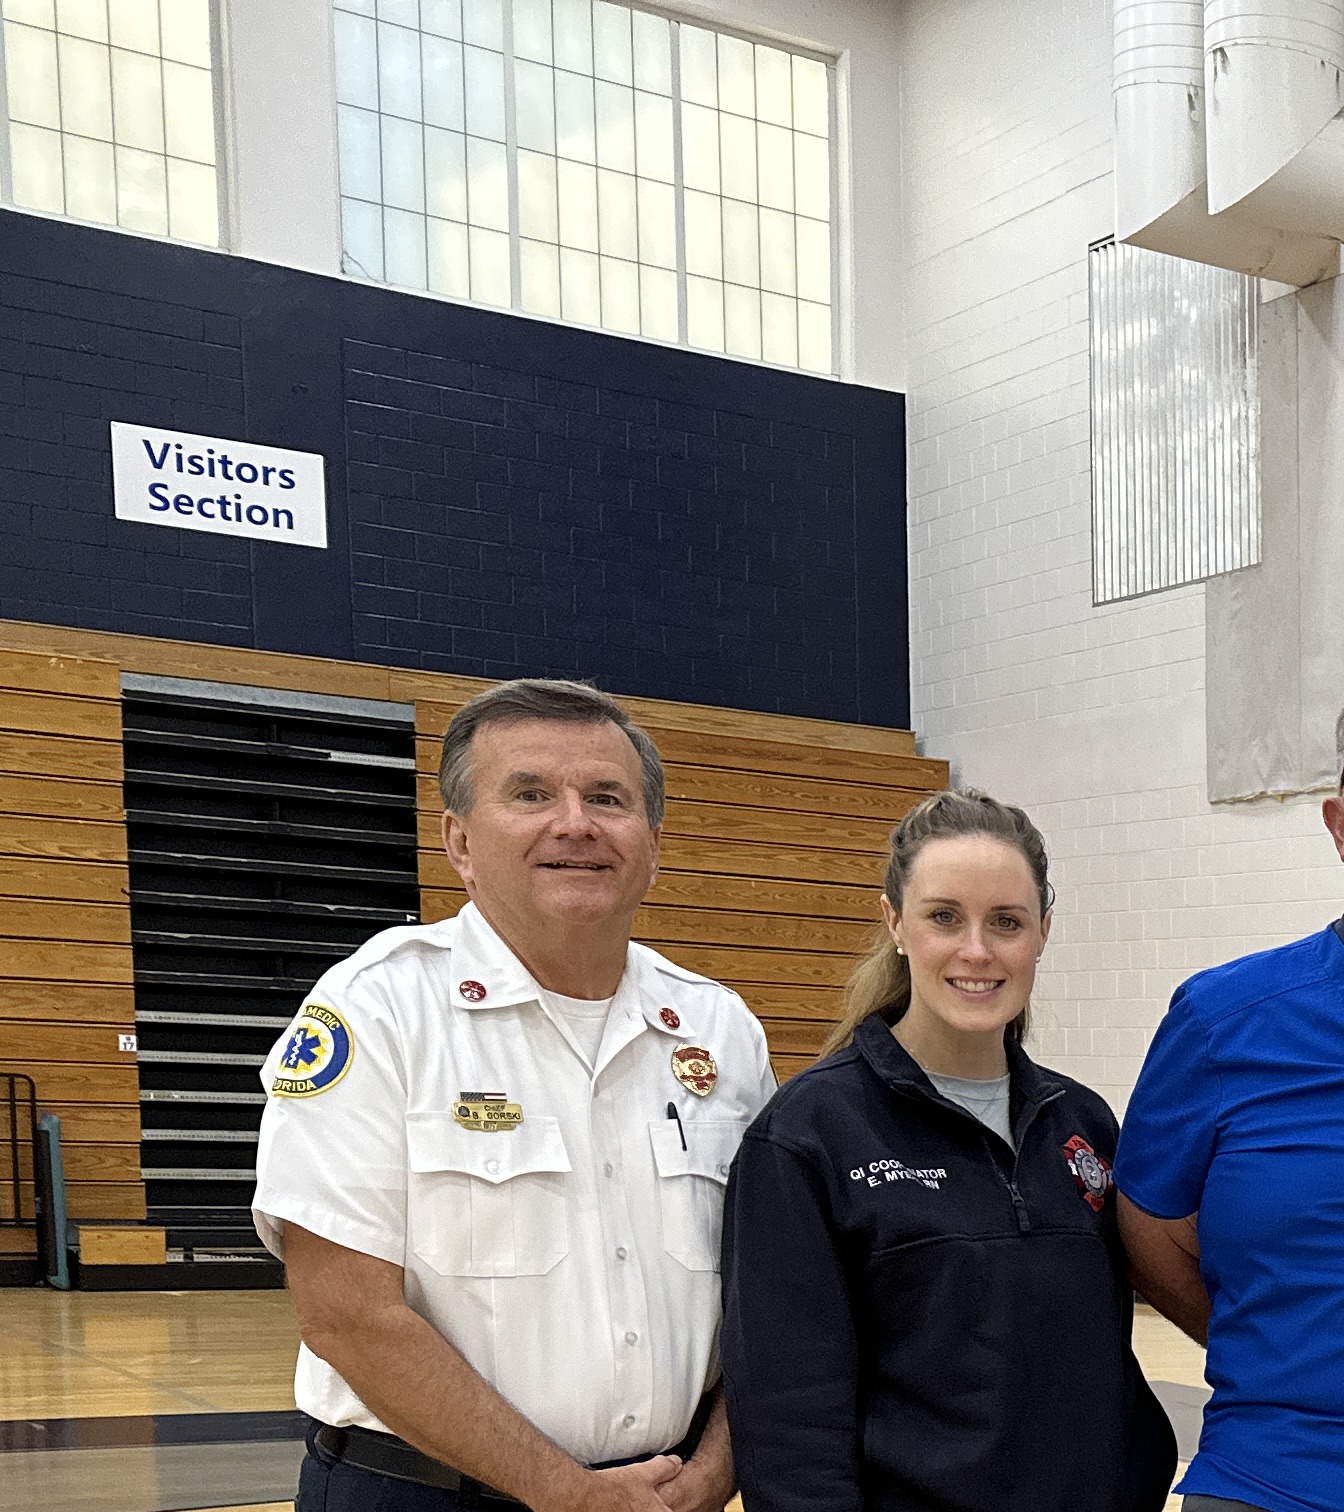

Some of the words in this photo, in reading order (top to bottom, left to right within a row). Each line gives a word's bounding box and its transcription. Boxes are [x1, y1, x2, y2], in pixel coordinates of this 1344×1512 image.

[142, 439, 296, 489] Visitors
[148, 483, 294, 530] Section
[303, 1006, 340, 1030] MEDIC
[851, 1168, 864, 1180] QI
